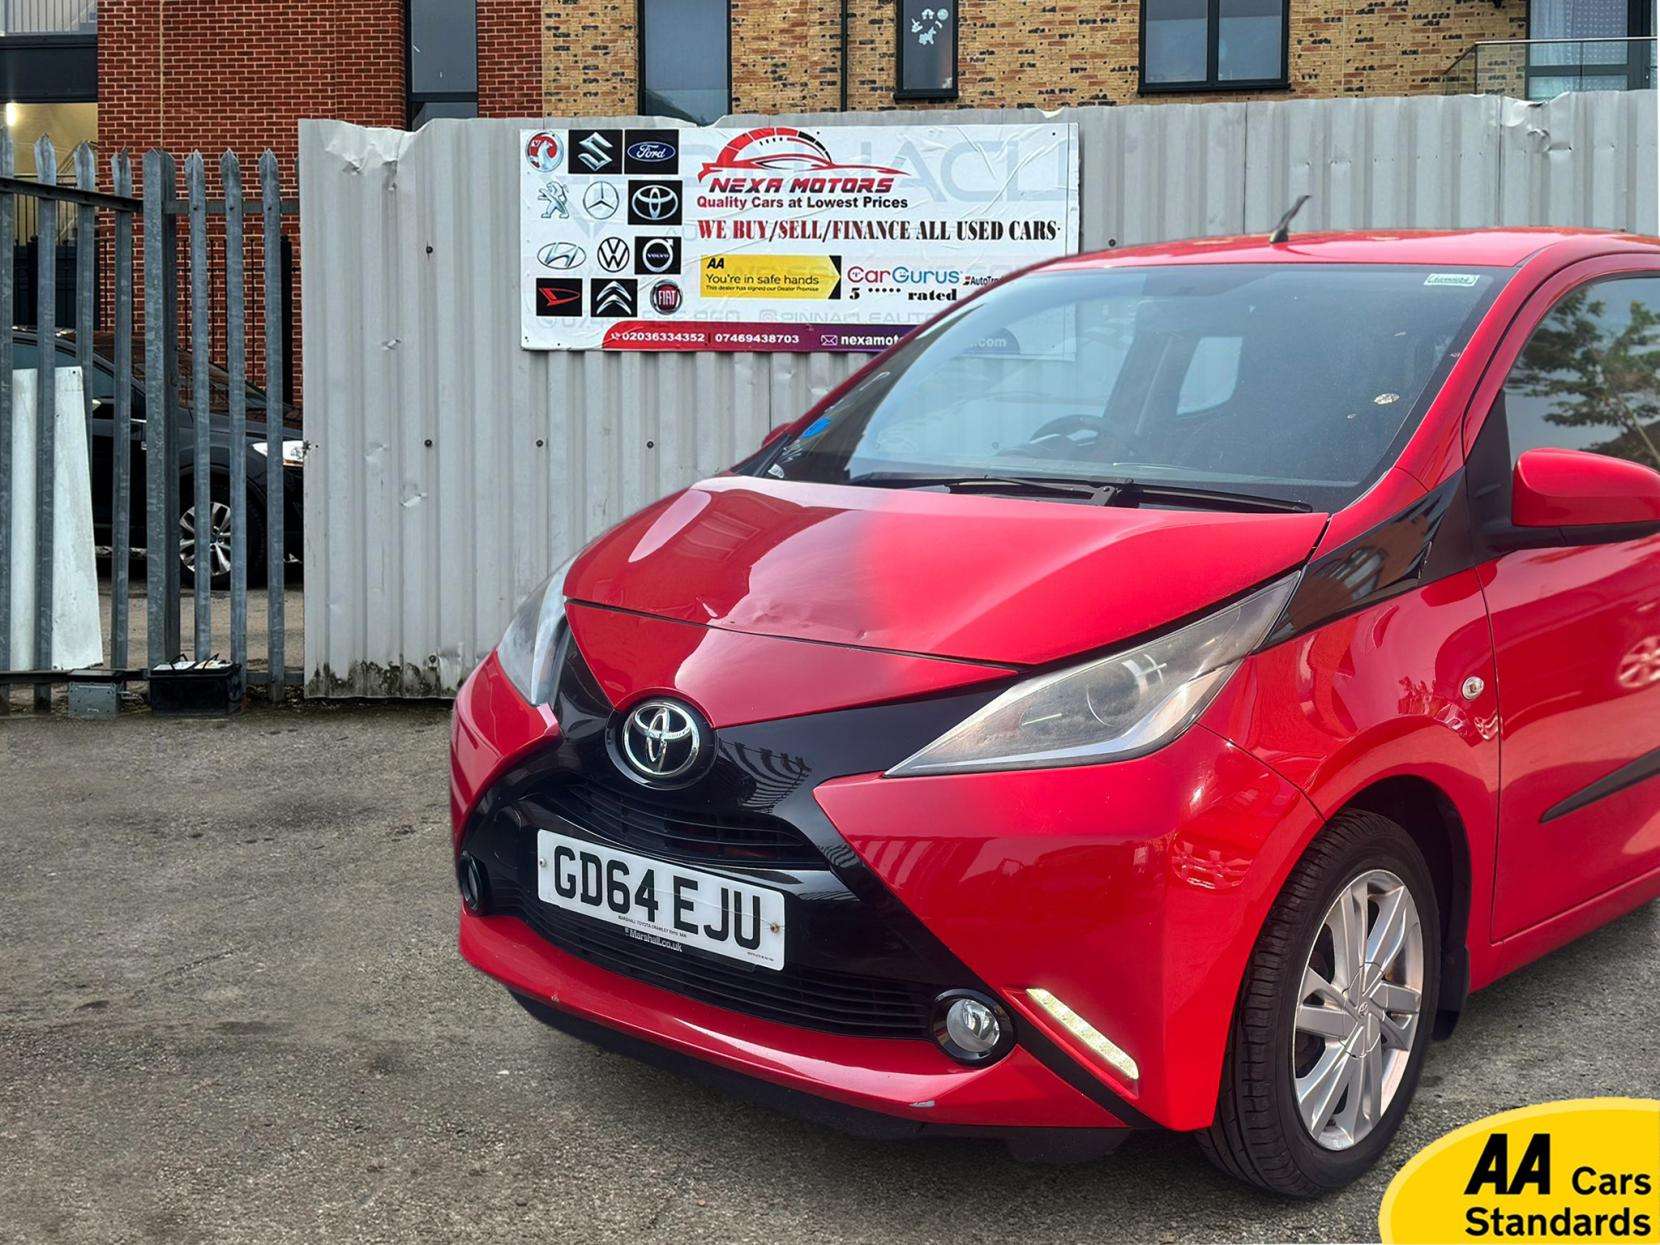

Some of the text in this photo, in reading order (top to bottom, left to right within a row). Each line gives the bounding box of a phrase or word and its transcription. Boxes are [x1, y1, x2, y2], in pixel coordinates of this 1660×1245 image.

[636, 142, 666, 159] Ford
[708, 177, 895, 194] NEXA MOTORS
[697, 195, 909, 210] Quality Cars at Lowest Prices
[697, 219, 1057, 243] WE BUY/SELL/FINANCE ALL USED CARS
[706, 257, 725, 270] AA
[705, 273, 820, 285] You're in safe hands
[847, 266, 960, 284] CarGurus
[658, 290, 677, 306] FIAT
[849, 287, 958, 301] 5 rated
[622, 332, 799, 343] 02036334352 07469438703
[840, 334, 901, 346] nexamot
[553, 845, 761, 950] GD64 EJU
